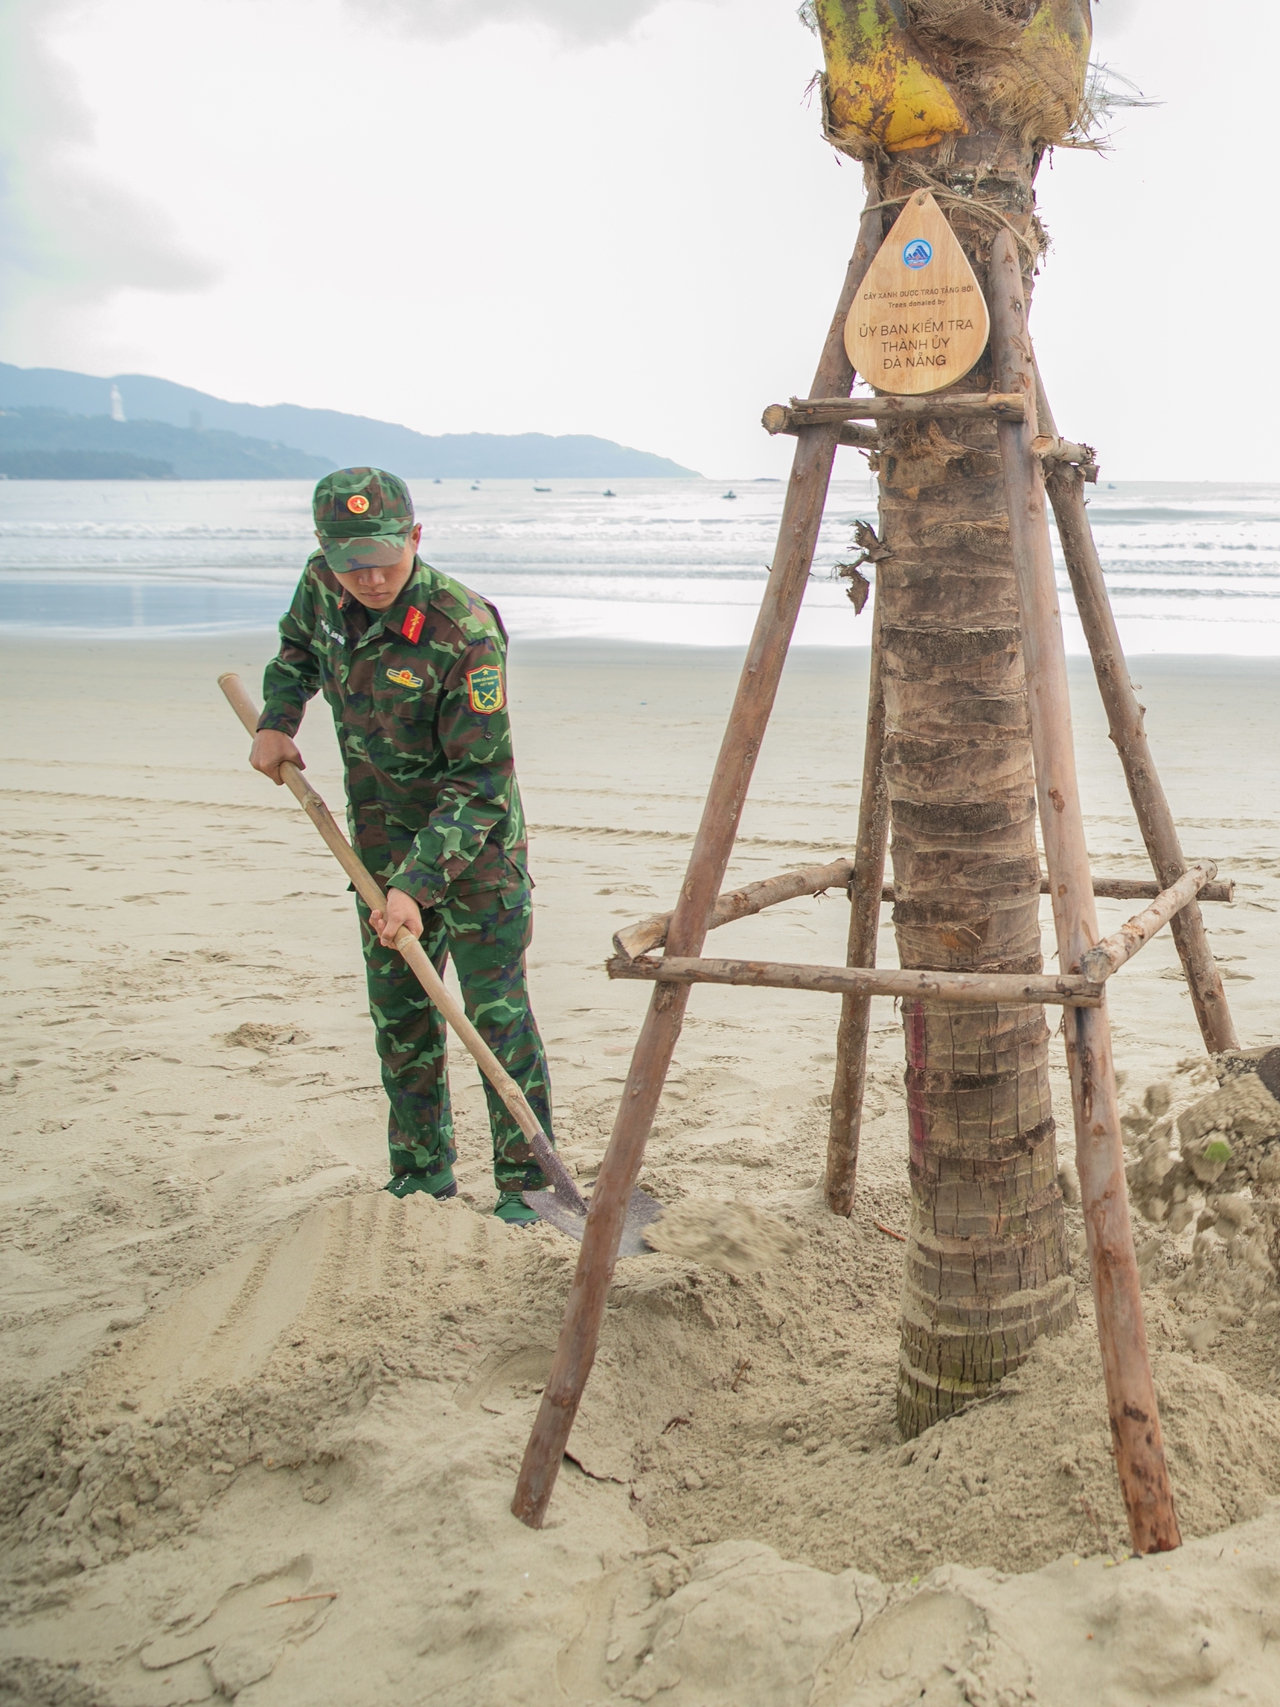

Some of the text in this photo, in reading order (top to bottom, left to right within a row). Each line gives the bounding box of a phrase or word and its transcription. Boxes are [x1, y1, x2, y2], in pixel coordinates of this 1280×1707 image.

[863, 292, 877, 300] CÂY
[878, 291, 898, 299] XANH
[920, 288, 939, 296] TRAO
[859, 317, 974, 338] ỦY BAN KIỂM TRA
[881, 335, 950, 353] THÀNH ỦY
[883, 355, 902, 370] ĐÀ
